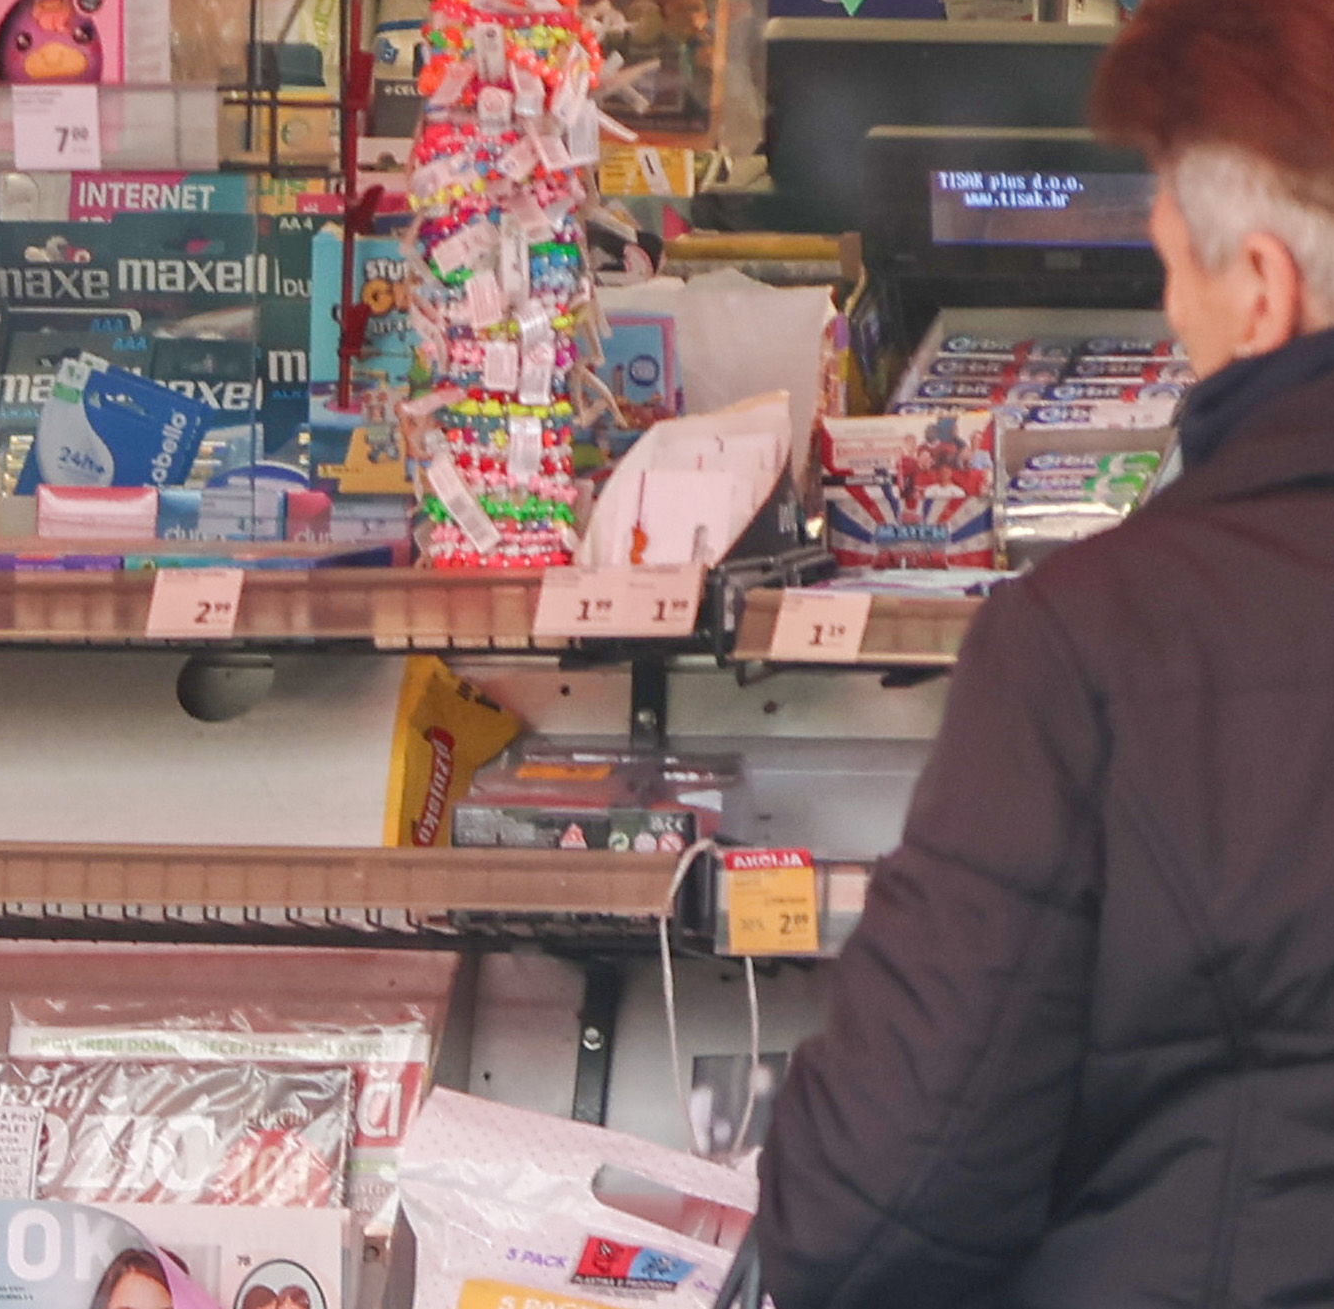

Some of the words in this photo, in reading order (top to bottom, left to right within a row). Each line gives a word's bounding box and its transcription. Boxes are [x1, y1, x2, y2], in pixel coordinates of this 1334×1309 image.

[939, 171, 985, 190] TISAK
[990, 172, 1026, 194] plus
[1033, 172, 1085, 191] d.o.o.
[78, 181, 215, 213] INTERNET
[279, 216, 299, 230] AA
[118, 255, 267, 294] maxell
[733, 852, 805, 870] AKCIJA
[506, 1247, 517, 1261] 5
[523, 1250, 567, 1269] PACK
